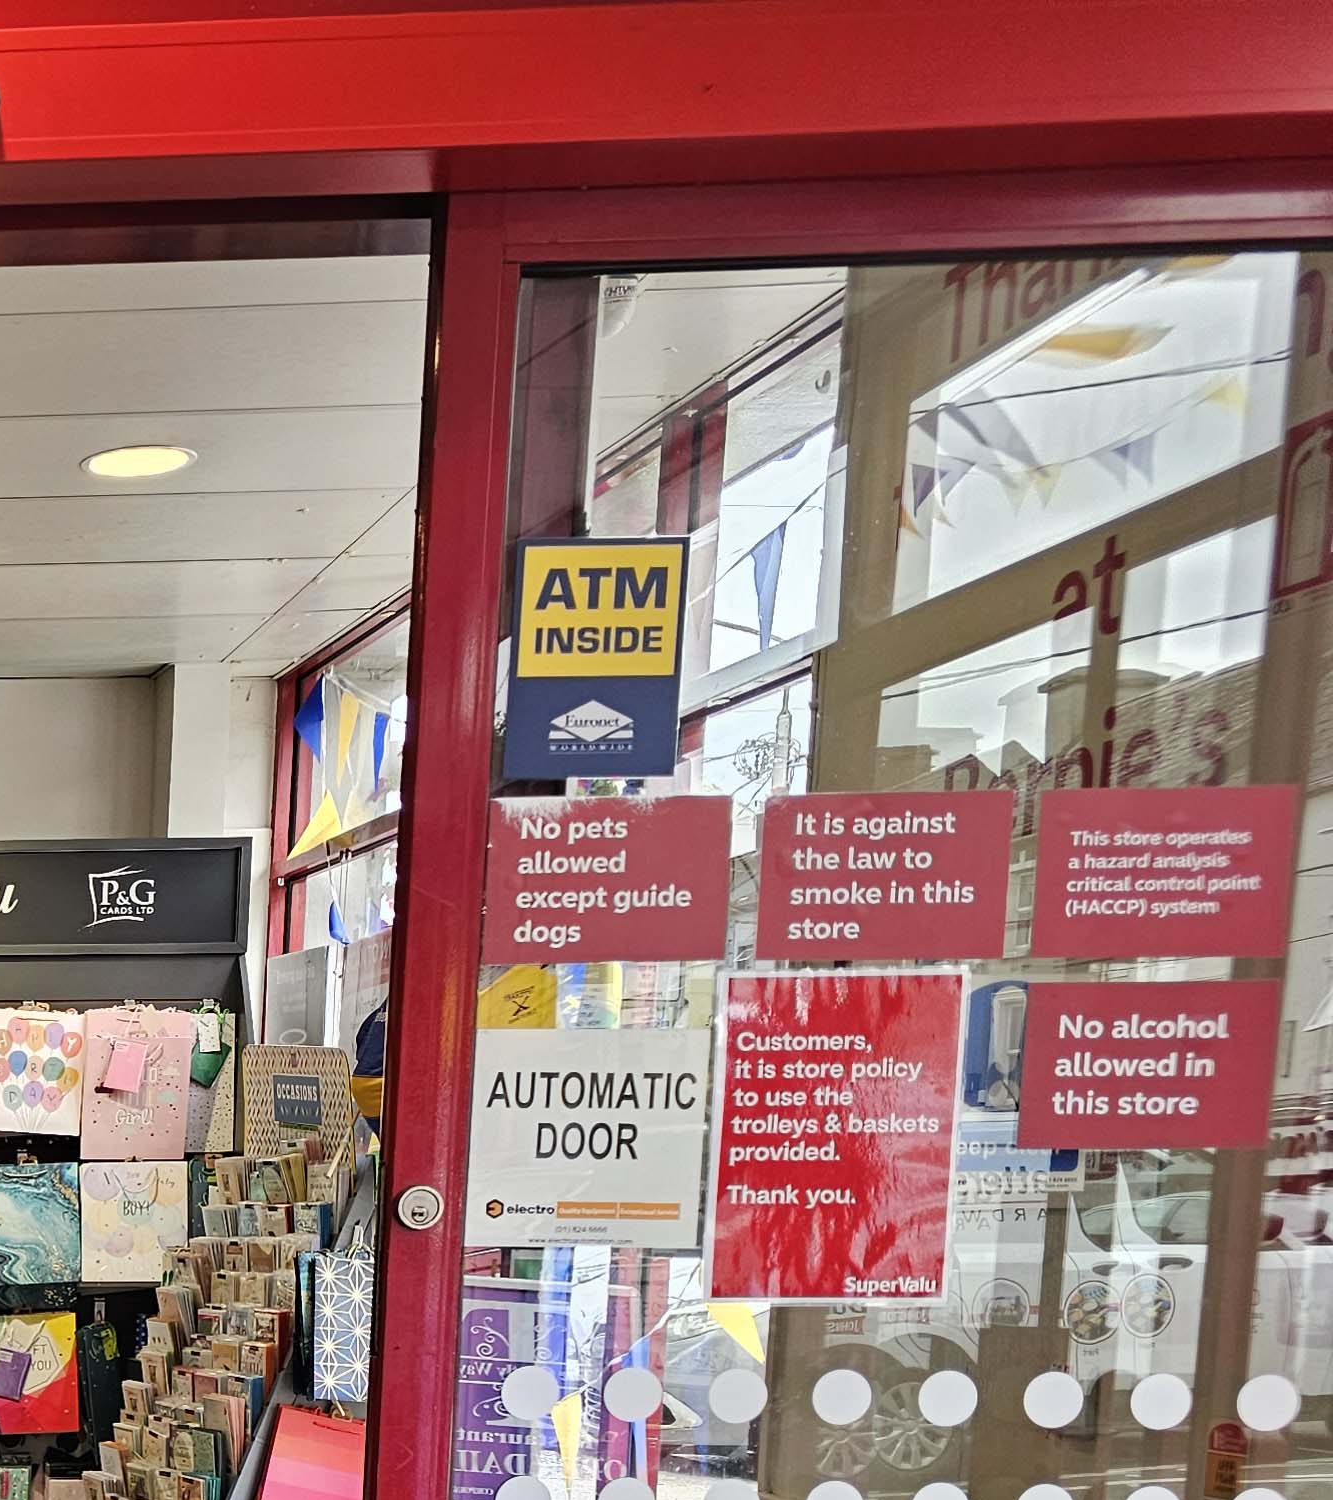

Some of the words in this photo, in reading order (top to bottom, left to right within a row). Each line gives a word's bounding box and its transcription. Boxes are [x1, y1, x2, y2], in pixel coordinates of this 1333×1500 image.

[535, 566, 669, 610] ATM
[534, 626, 663, 654] INSIDE
[565, 714, 620, 729] Euronet
[520, 818, 560, 841] No
[568, 816, 629, 845] pets
[795, 812, 817, 835] It
[823, 812, 845, 835] is
[853, 811, 956, 841] against
[1071, 830, 1110, 847] This
[1113, 831, 1162, 847] store
[1165, 829, 1252, 851] operates
[517, 850, 626, 875] allowed
[793, 848, 842, 870] the
[848, 847, 893, 869] law
[903, 849, 933, 869] to
[1068, 855, 1079, 870] a
[1084, 851, 1150, 869] hazard
[1152, 850, 1230, 872] analysis
[100, 879, 157, 907] P&G
[789, 882, 883, 905] smoke
[890, 882, 914, 904] in
[923, 881, 975, 904] this
[1066, 876, 1132, 893] critical
[1134, 876, 1205, 893] control
[1207, 875, 1260, 896] point
[100, 906, 133, 916] CARDS
[135, 906, 155, 916] LTD
[515, 887, 607, 914] except
[613, 884, 693, 914] guide
[1065, 898, 1147, 919] (HACCP)
[1150, 899, 1219, 918] system
[513, 921, 582, 949] dogs
[787, 919, 860, 940] store
[1058, 1014, 1104, 1039] No
[1112, 1012, 1229, 1039] alcohol
[737, 1031, 873, 1056] Customers,
[734, 1059, 752, 1079] it
[757, 1058, 776, 1079] is
[782, 1061, 843, 1080] store
[851, 1057, 923, 1083] policy
[1054, 1051, 1178, 1077] allowed
[1185, 1052, 1215, 1077] in
[276, 1081, 318, 1102] OCCASIONS
[486, 1071, 697, 1111] AUTOMATIC
[733, 1088, 758, 1106] to
[765, 1089, 807, 1106] use
[813, 1086, 854, 1106] the
[1052, 1090, 1111, 1115] this
[1117, 1093, 1199, 1115] store
[731, 1113, 819, 1139] trolleys
[824, 1115, 842, 1134] &
[848, 1114, 939, 1134] baskets
[534, 1122, 638, 1161] DOOR
[728, 1141, 841, 1166] provided.
[506, 1203, 555, 1215] electro
[726, 1184, 801, 1206] Thank
[805, 1187, 856, 1209] you.
[844, 1275, 937, 1294] SuperValu
